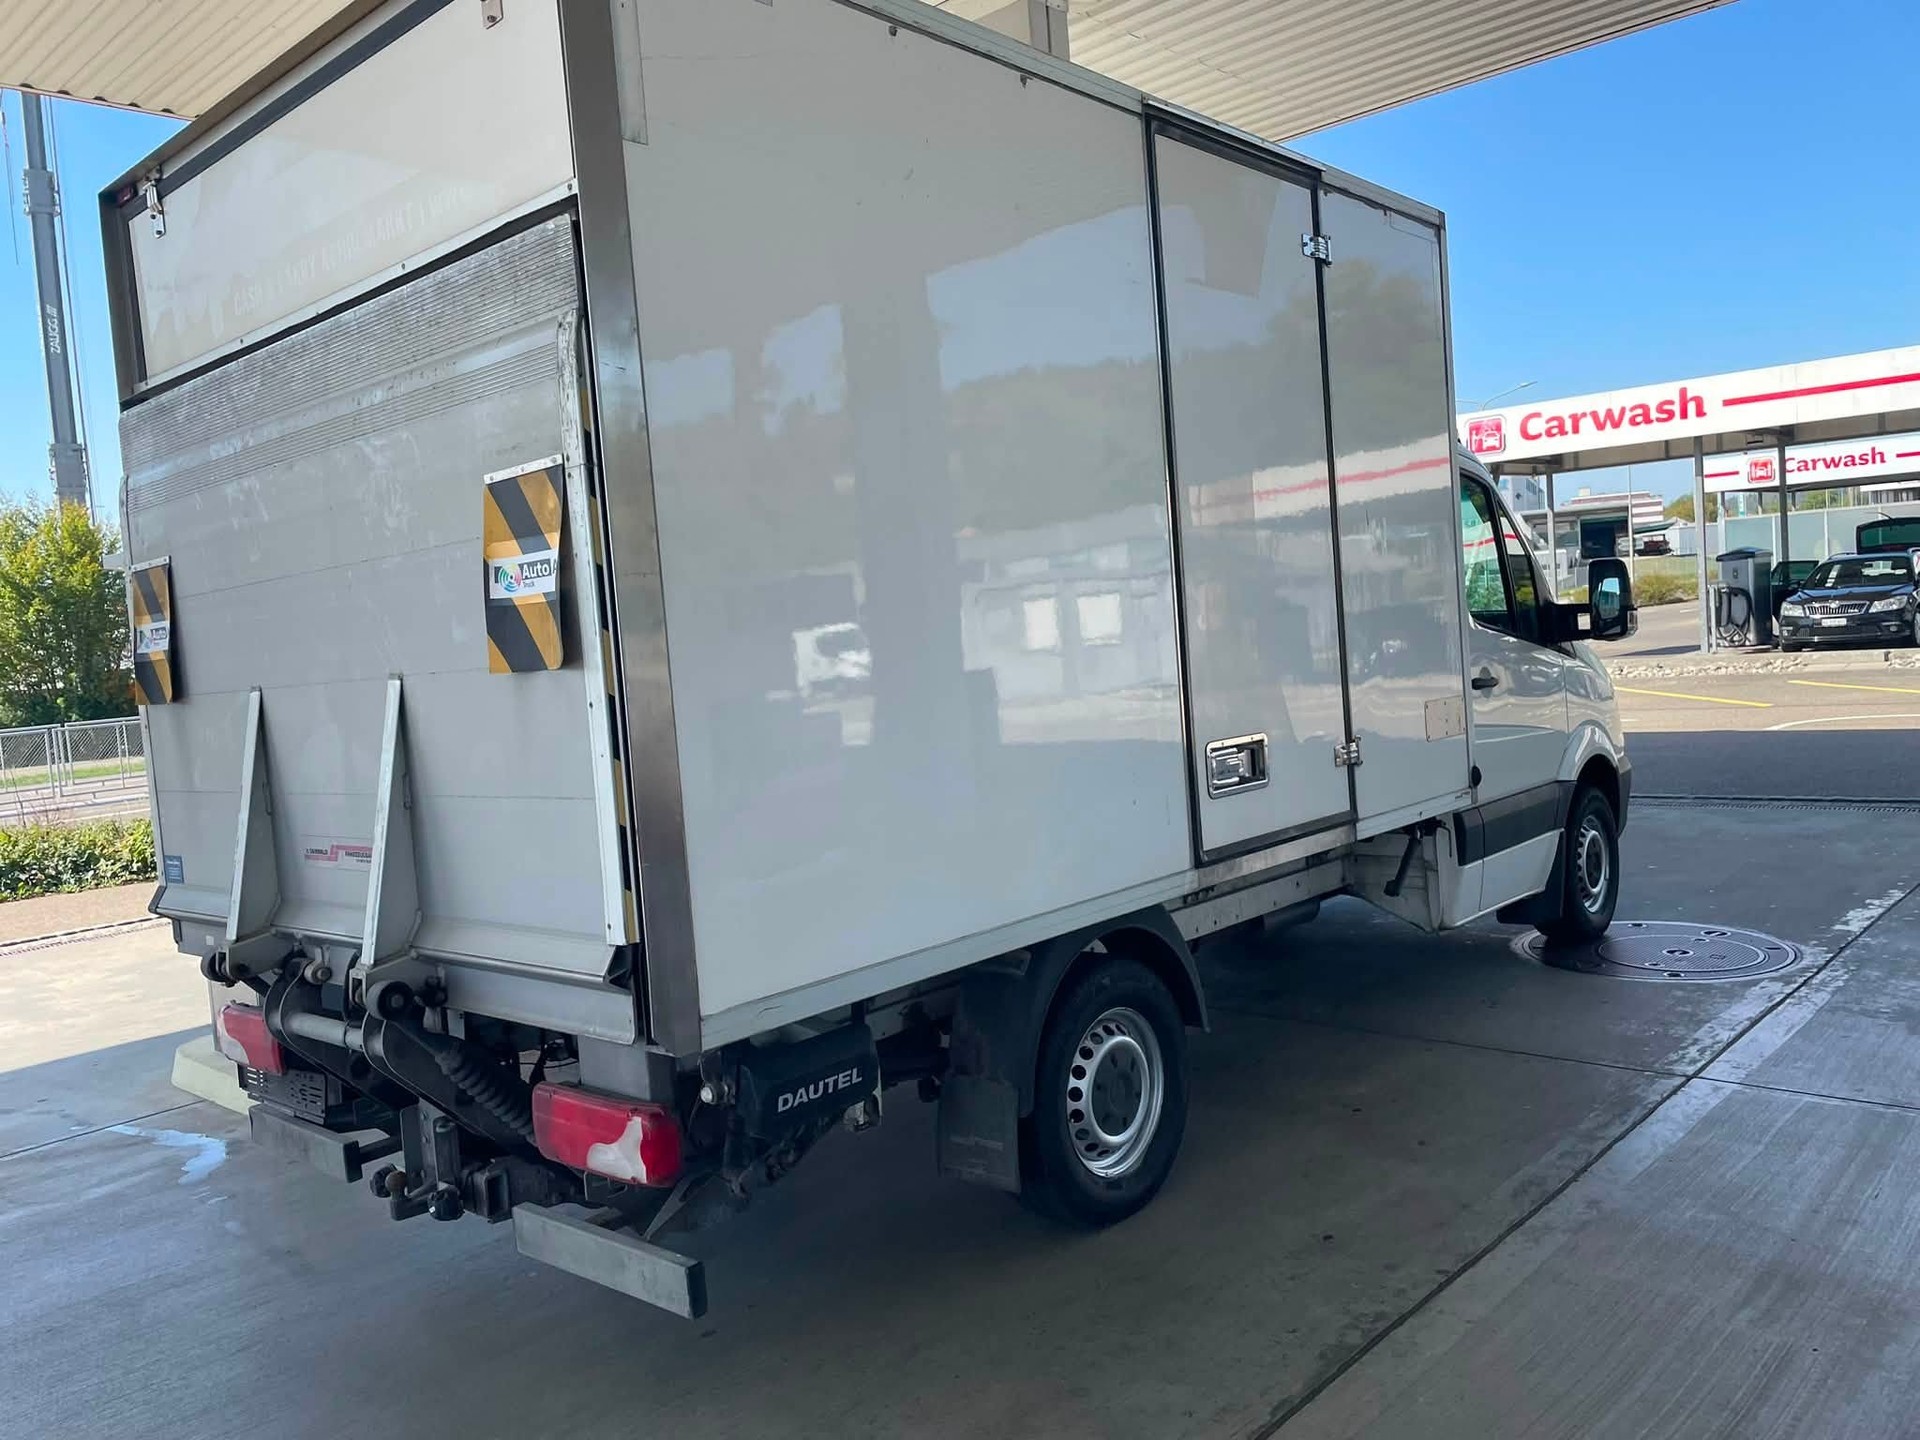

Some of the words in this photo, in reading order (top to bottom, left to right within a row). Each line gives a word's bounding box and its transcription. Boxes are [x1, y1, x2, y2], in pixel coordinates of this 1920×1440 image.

[47, 318, 61, 353] ZAUGG
[1519, 387, 1707, 441] Carwash
[1785, 446, 1887, 473] Carwash
[522, 562, 550, 579] Auto
[777, 1066, 863, 1113] DAUTEL
